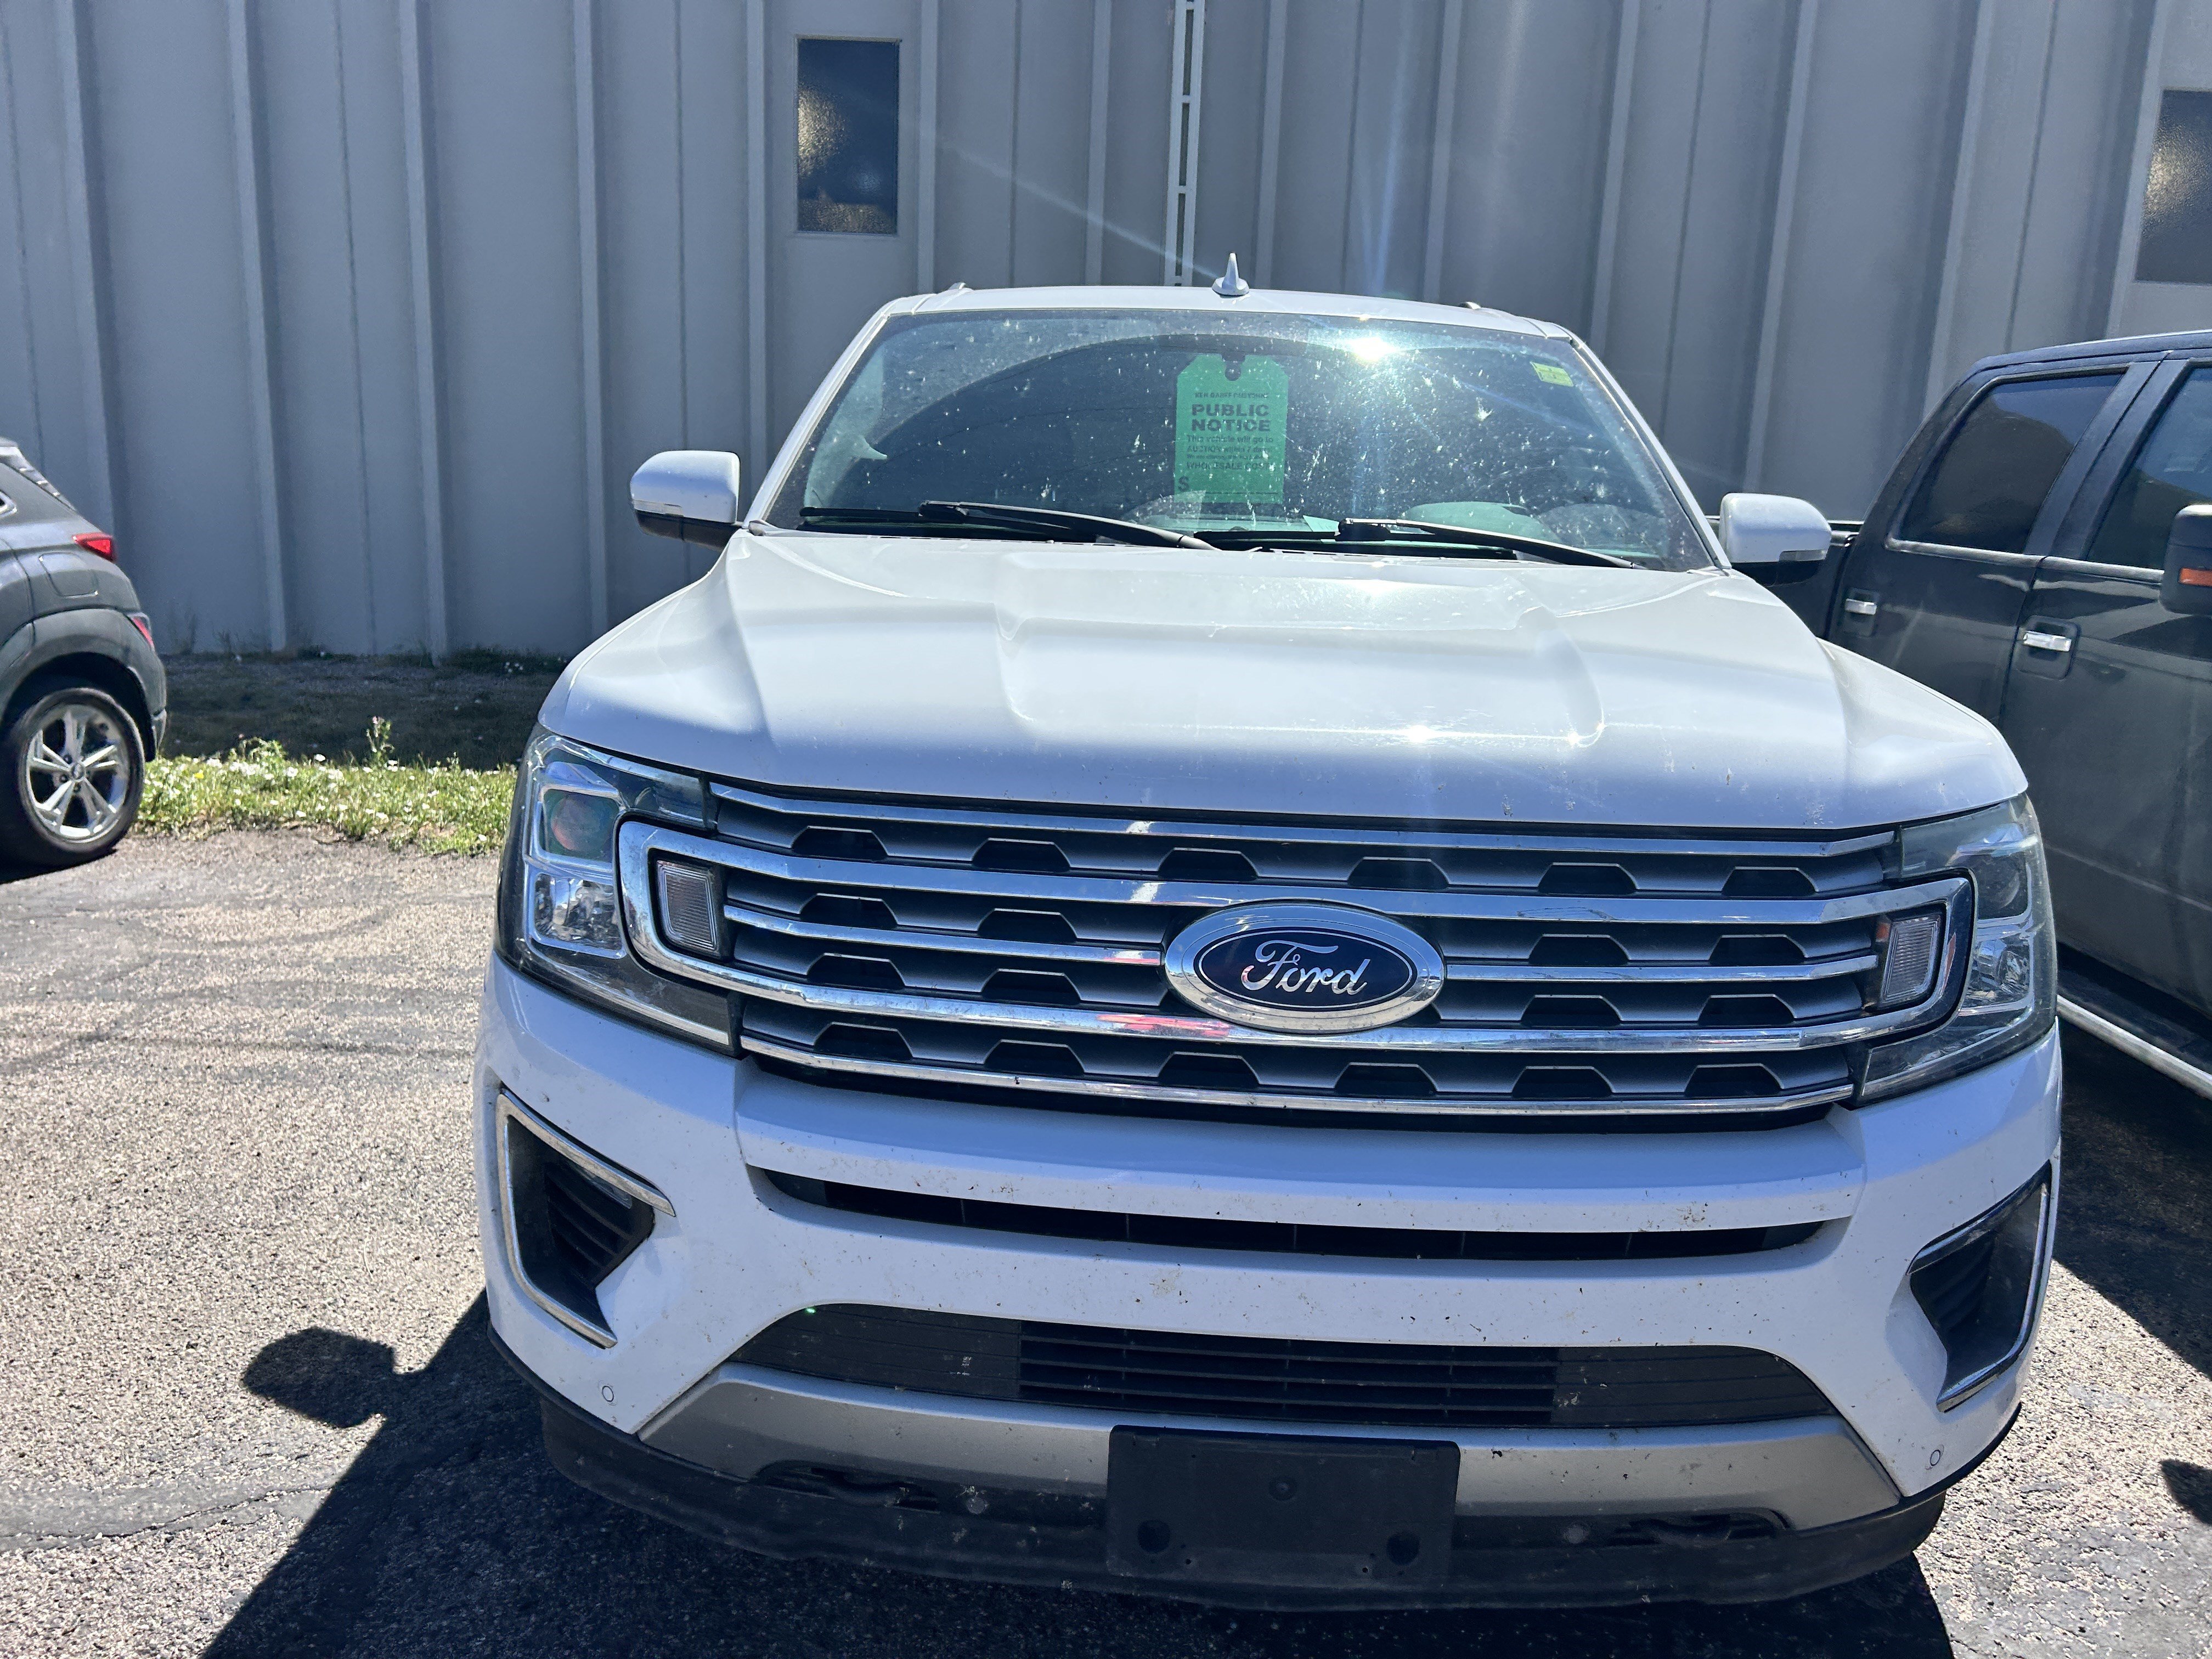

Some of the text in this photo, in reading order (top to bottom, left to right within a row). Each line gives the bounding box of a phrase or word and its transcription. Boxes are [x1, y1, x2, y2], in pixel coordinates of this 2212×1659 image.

[1192, 404, 1269, 417] PUBLIC
[1191, 419, 1271, 432] NOTICE
[1187, 434, 1204, 443] This
[1253, 437, 1263, 445] go
[1241, 940, 1371, 996] Ford
